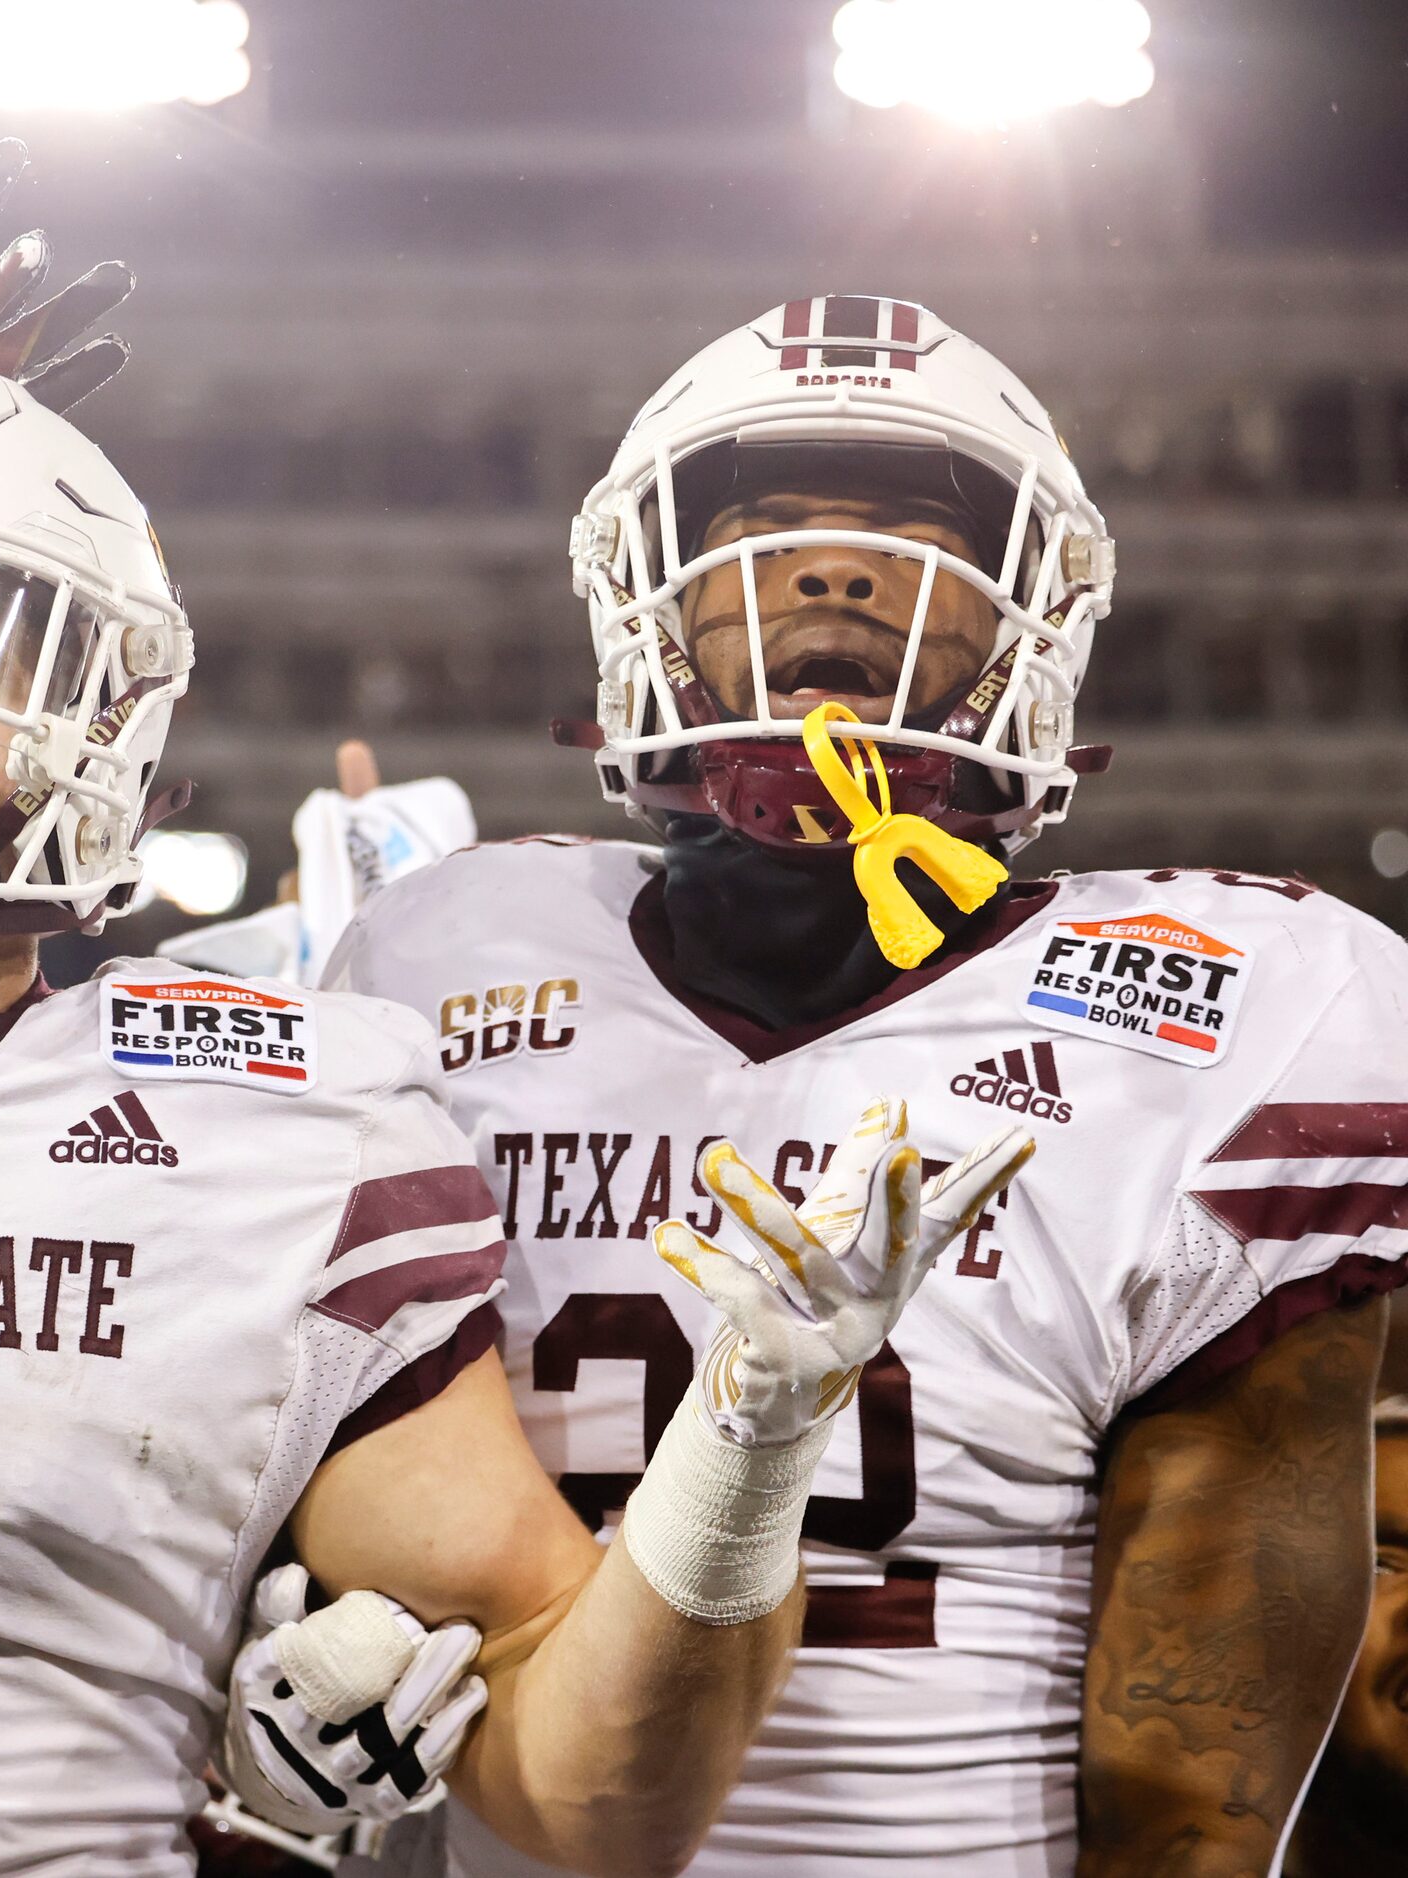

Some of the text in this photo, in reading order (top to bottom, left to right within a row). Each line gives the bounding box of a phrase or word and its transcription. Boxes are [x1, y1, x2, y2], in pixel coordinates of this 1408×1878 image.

[966, 670, 1009, 714] EAT
[1098, 923, 1199, 948] SERVPRO
[1041, 936, 1239, 1002] F1RST
[154, 986, 257, 1003] SERVPRO
[1033, 969, 1225, 1031] RESPONDER
[111, 997, 304, 1041] F1RST
[440, 978, 580, 1072] SBC
[1088, 1004, 1154, 1036] BOWL
[111, 1031, 306, 1063] RESPONDER
[175, 1053, 243, 1072] BOWL
[949, 1068, 1073, 1124] adidas
[48, 1134, 180, 1168] adidas
